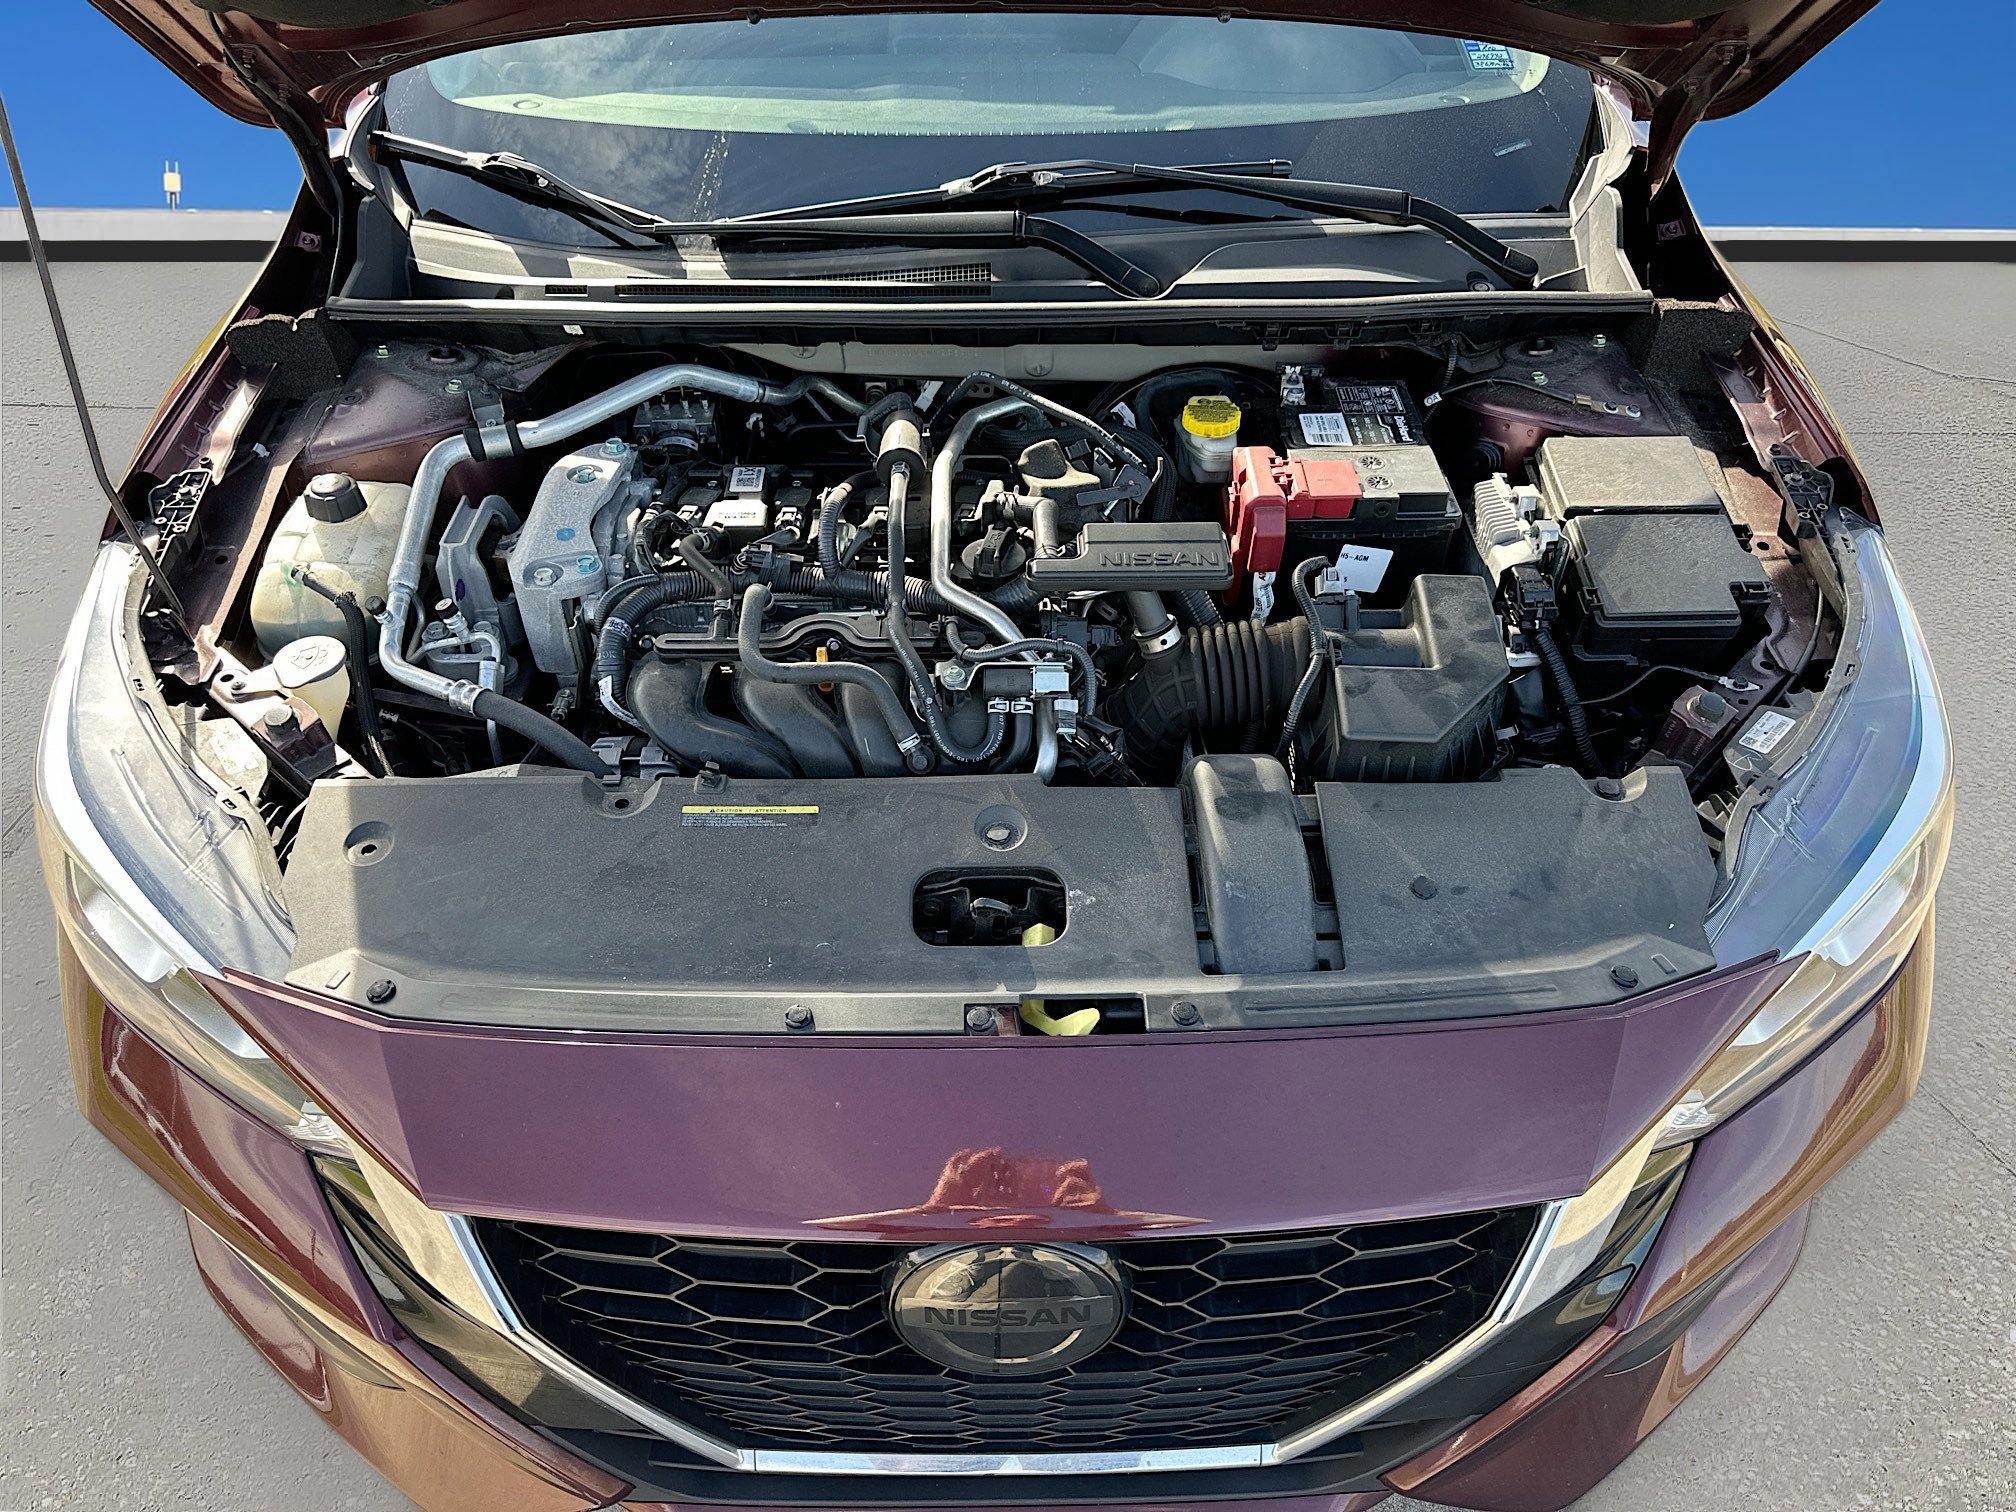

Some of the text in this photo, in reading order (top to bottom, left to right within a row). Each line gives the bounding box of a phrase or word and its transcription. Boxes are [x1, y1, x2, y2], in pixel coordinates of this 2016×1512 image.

[1393, 415, 1414, 441] DieHard
[1100, 551, 1219, 566] NISSAN
[924, 1304, 1091, 1327] NISSAN
